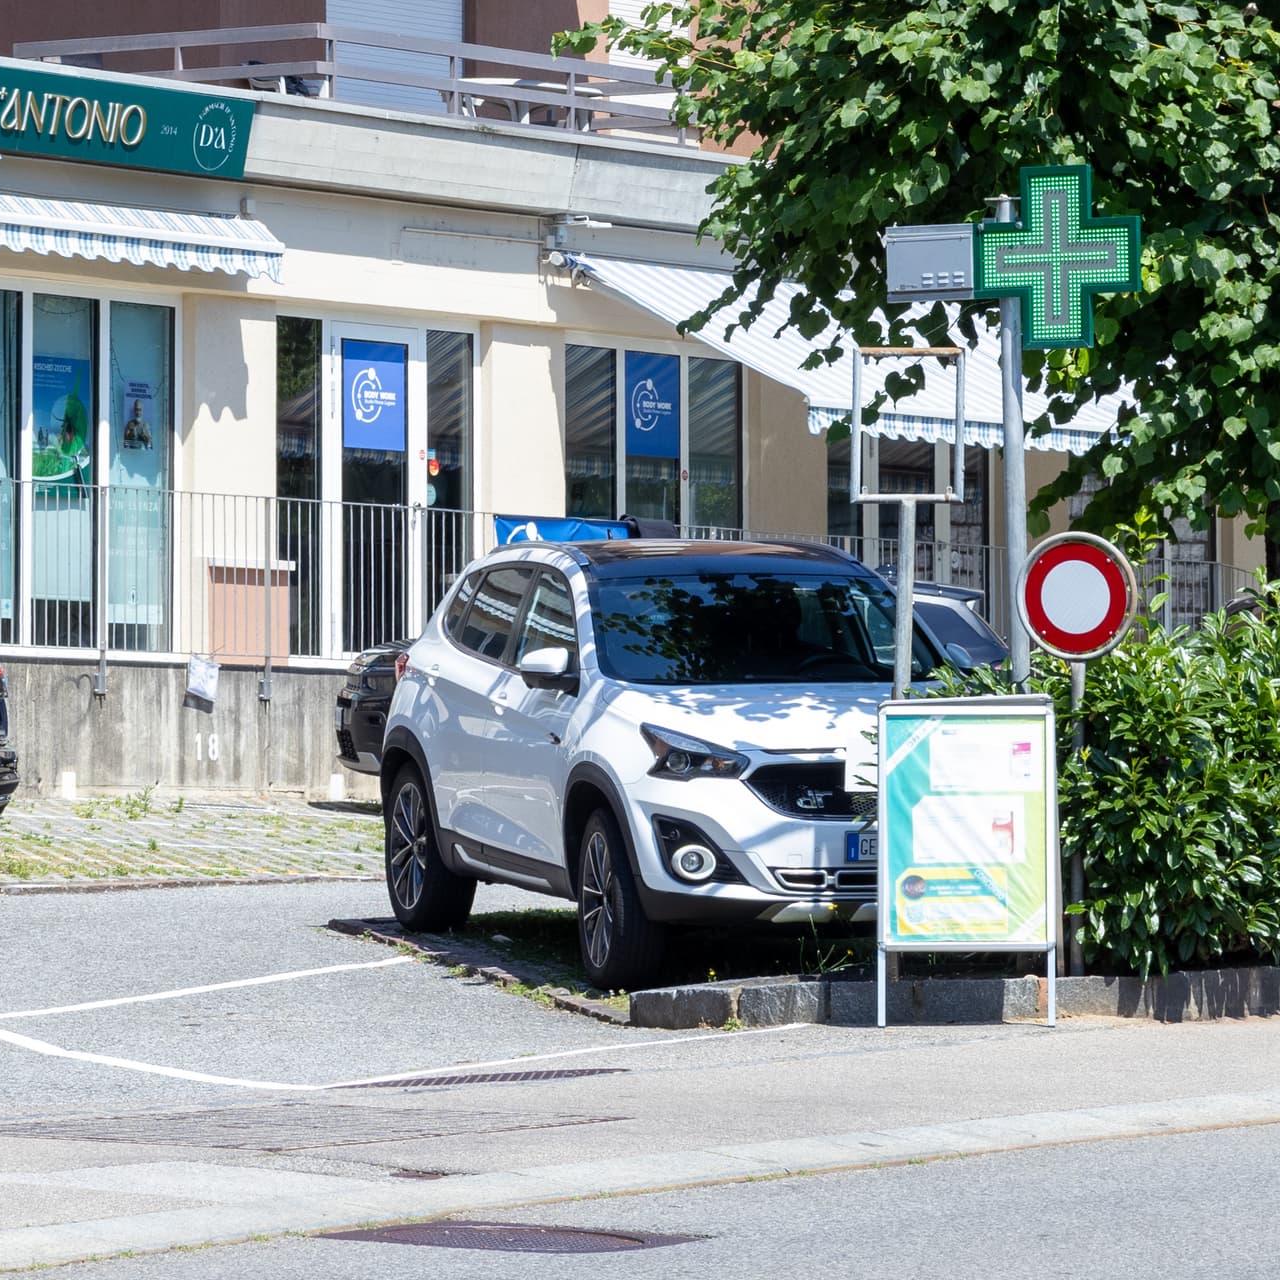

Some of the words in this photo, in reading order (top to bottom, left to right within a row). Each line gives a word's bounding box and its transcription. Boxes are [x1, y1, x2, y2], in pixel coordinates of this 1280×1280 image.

[160, 124, 178, 136] 2014
[364, 390, 379, 399] BODY
[380, 391, 396, 400] WORK
[643, 400, 656, 409] BODY
[657, 402, 672, 410] WORK
[195, 732, 219, 761] 18
